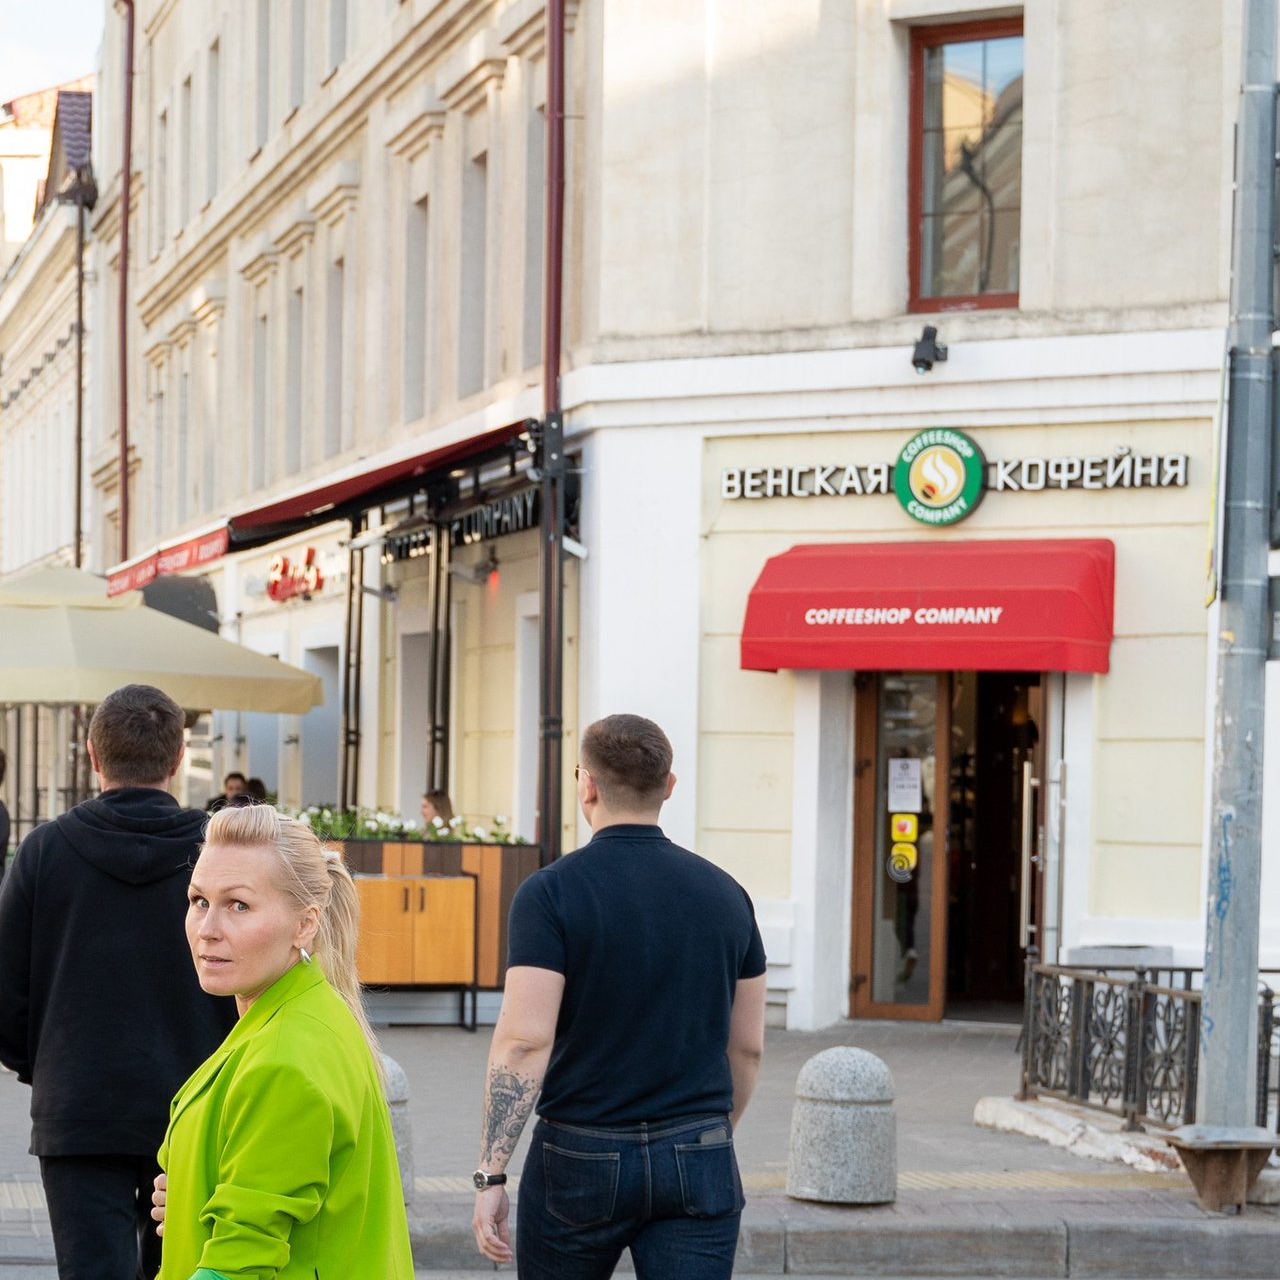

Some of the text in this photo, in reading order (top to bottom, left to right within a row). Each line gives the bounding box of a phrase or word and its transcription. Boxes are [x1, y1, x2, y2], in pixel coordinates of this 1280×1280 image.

[902, 429, 974, 462] COFFEESHOP
[721, 446, 1188, 499] ВЕНСКАЯ КОФЕЙНЯ
[907, 496, 968, 523] COMPANY
[805, 606, 1004, 625] COFFEESHOP COMPANY
